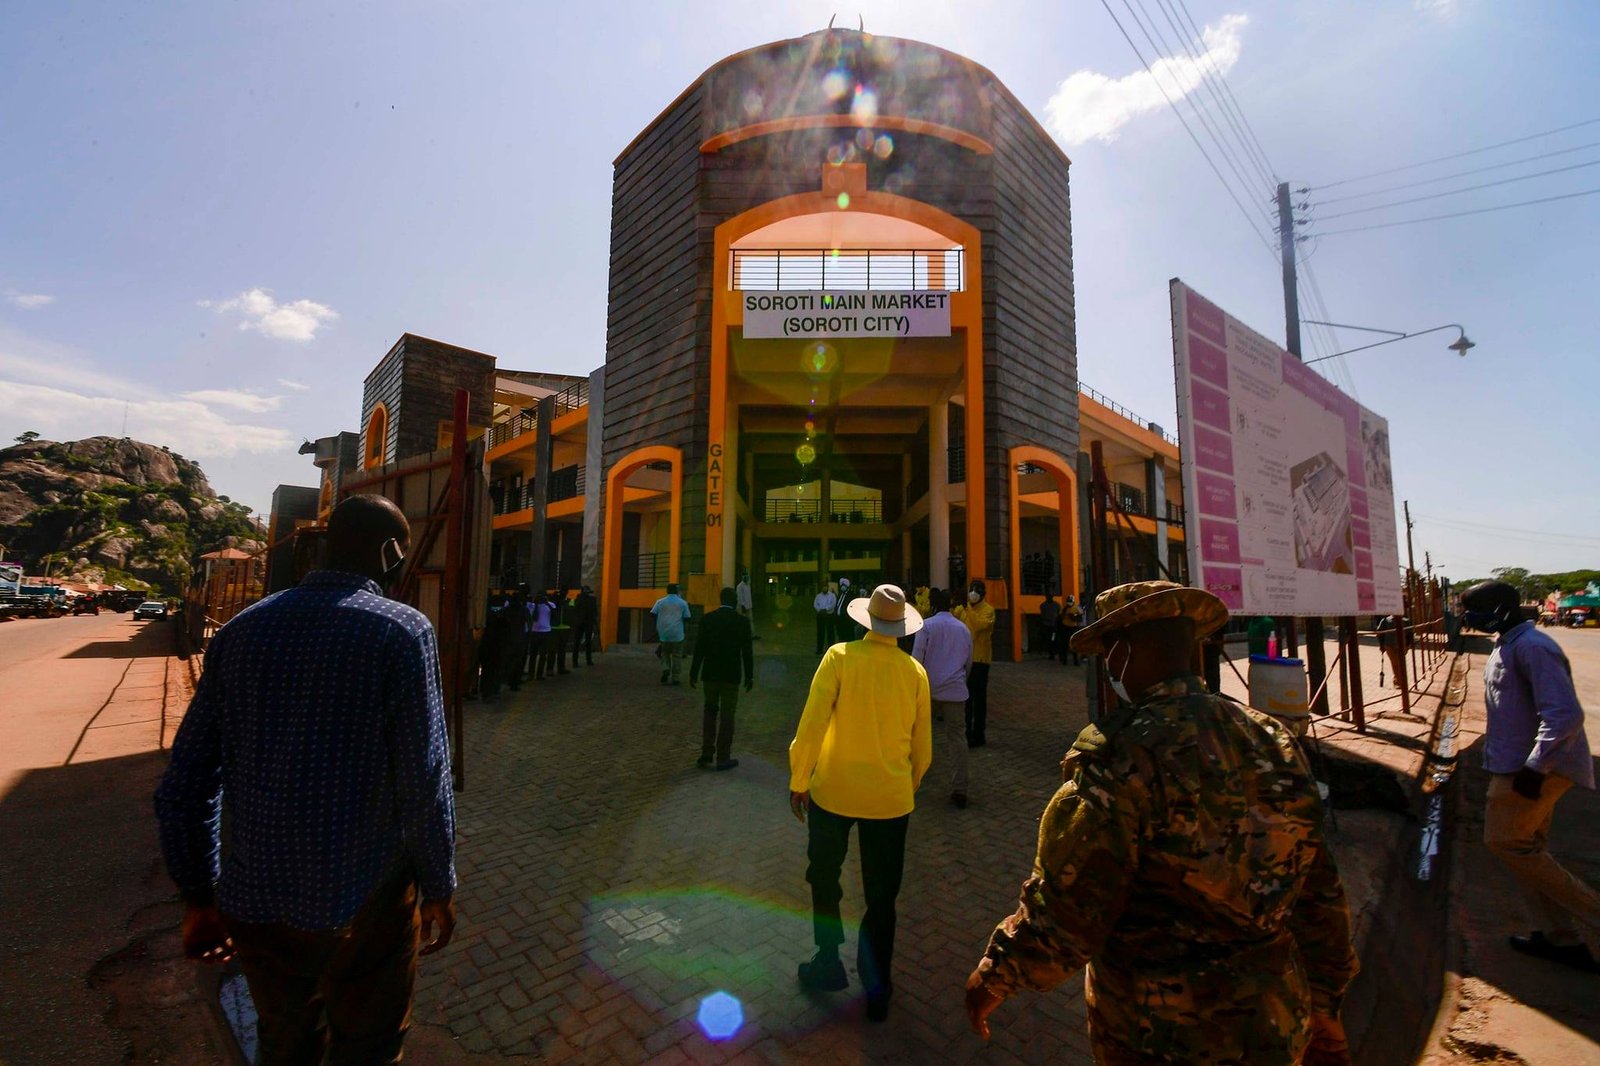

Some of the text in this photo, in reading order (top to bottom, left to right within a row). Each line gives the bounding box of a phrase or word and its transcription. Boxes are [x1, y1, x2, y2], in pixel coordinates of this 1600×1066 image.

[746, 294, 947, 311] SOROTI MAIN MARKET
[783, 316, 910, 335] (SOROTI CITY)
[707, 443, 722, 527] GATE 01
